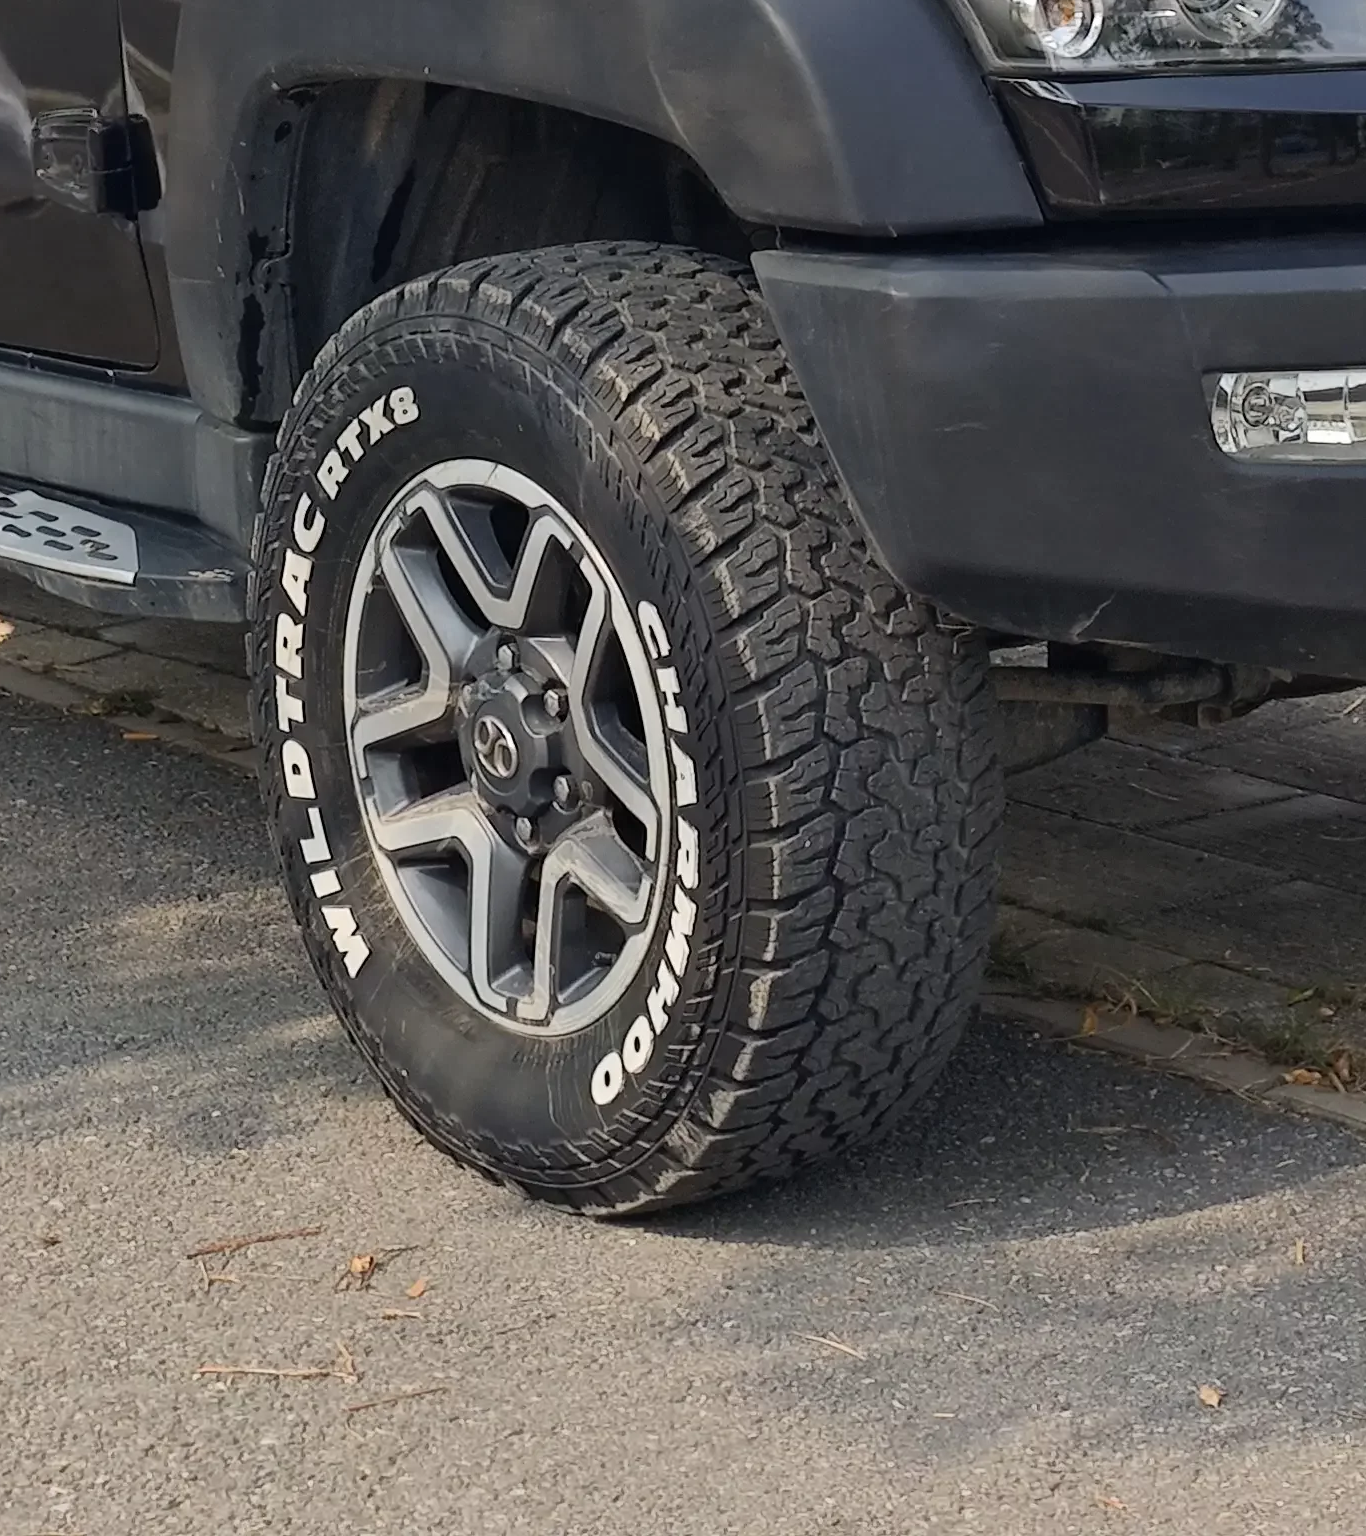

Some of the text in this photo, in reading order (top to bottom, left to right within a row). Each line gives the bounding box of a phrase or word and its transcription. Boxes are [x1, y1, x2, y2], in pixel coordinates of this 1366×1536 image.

[272, 385, 420, 981] WILDTRAC RTX8
[590, 599, 700, 1106] CHARMHOO
